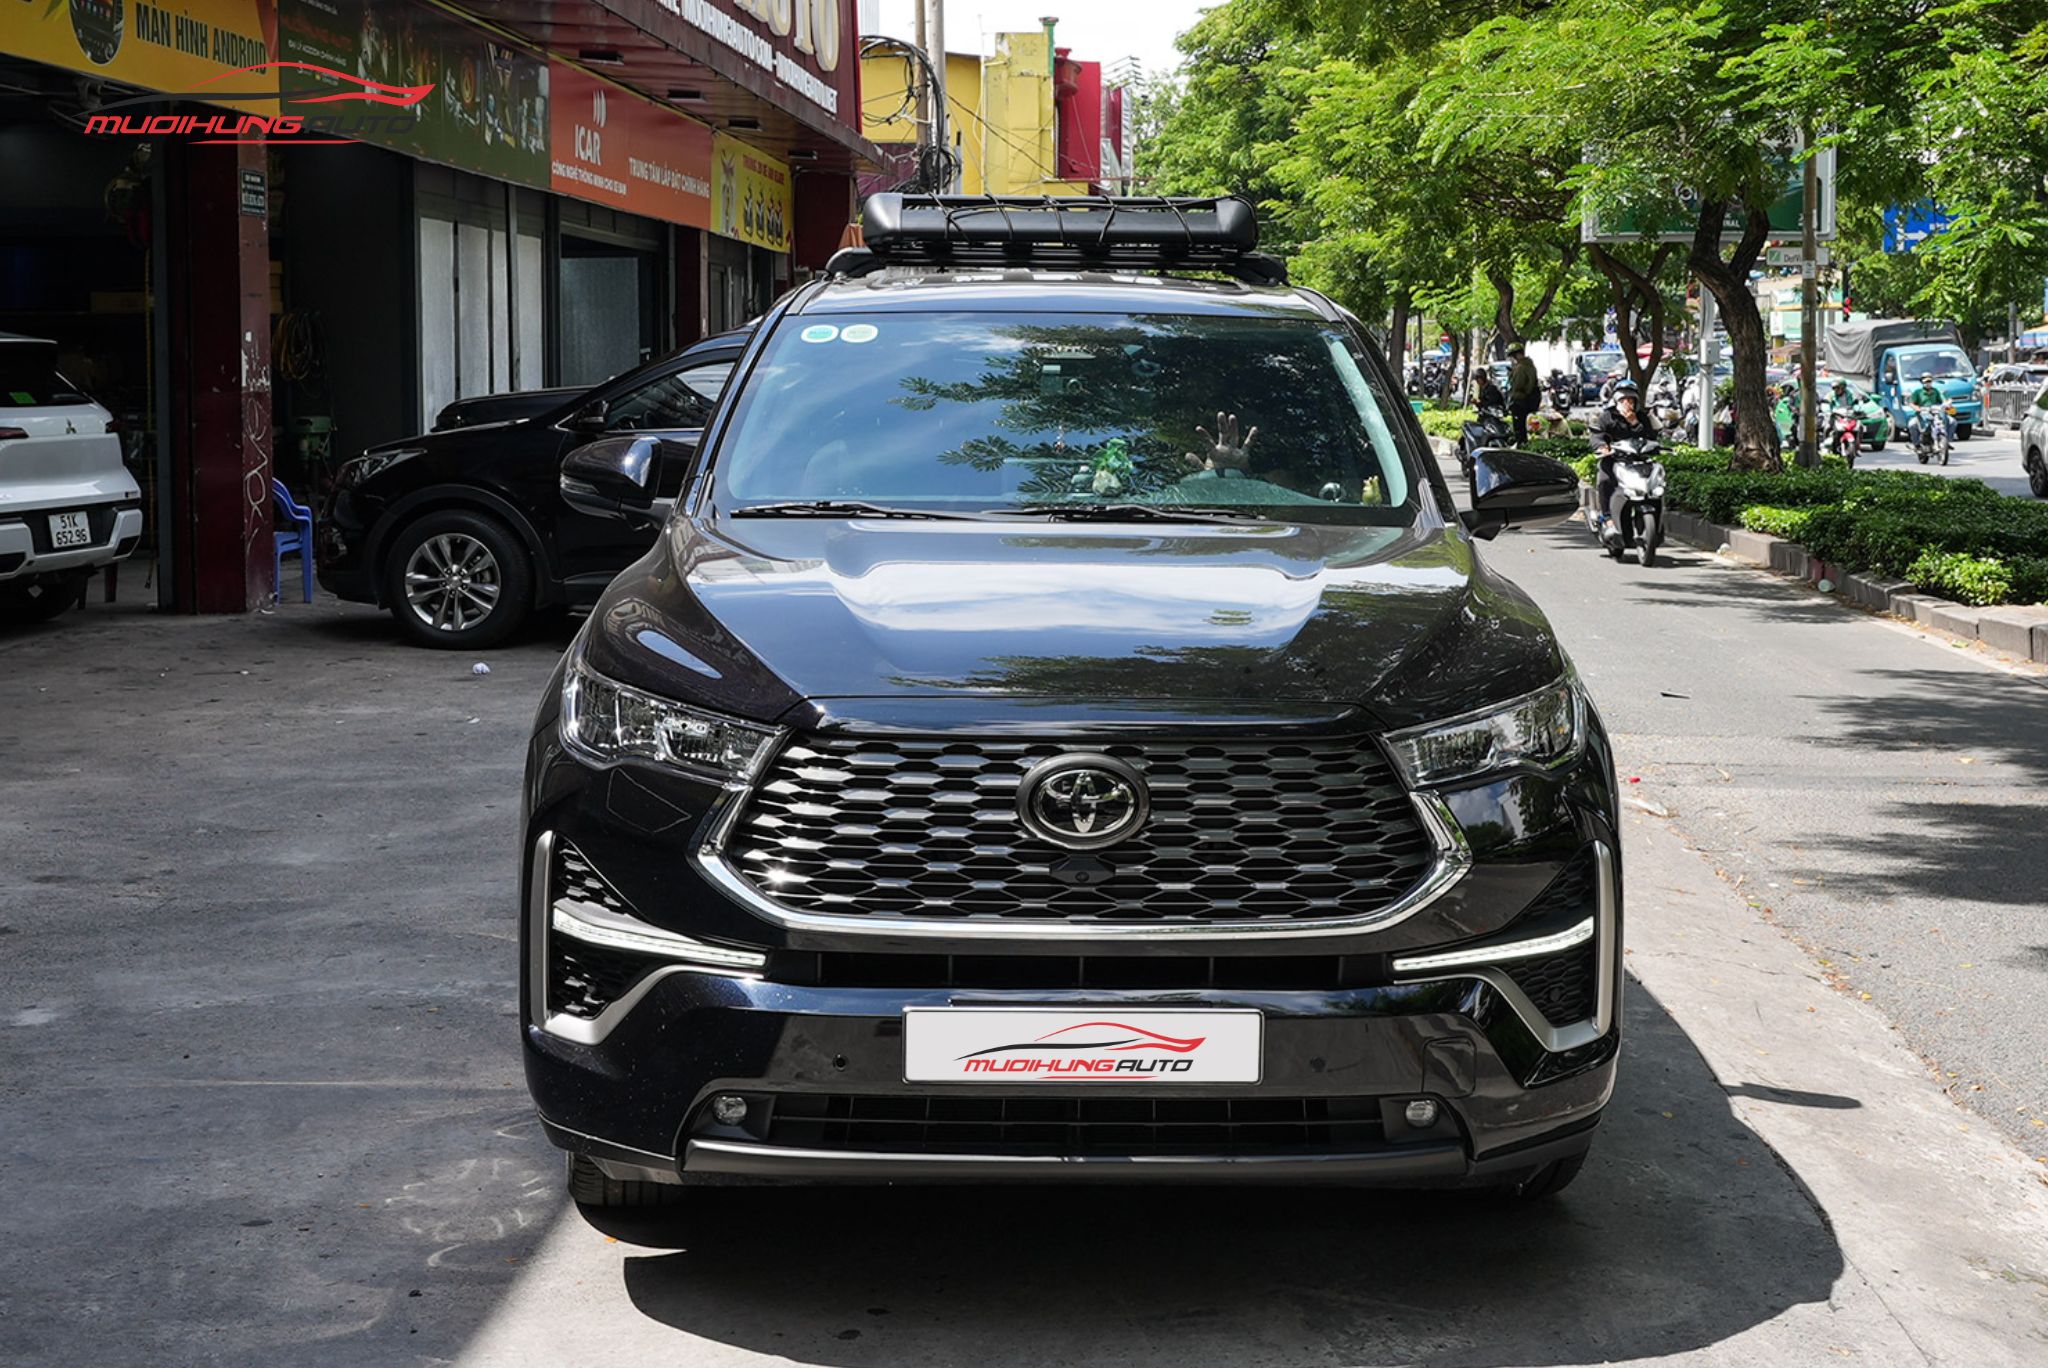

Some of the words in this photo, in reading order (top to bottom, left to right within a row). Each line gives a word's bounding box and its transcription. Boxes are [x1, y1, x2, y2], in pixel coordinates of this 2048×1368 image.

[135, 0, 171, 48] MÀN
[175, 8, 209, 59] HÌNH
[212, 27, 267, 75] ANDROID
[575, 124, 601, 166] ICAR
[628, 157, 649, 180] TRUNG
[649, 160, 661, 184] TÂM
[60, 513, 79, 529] 51K
